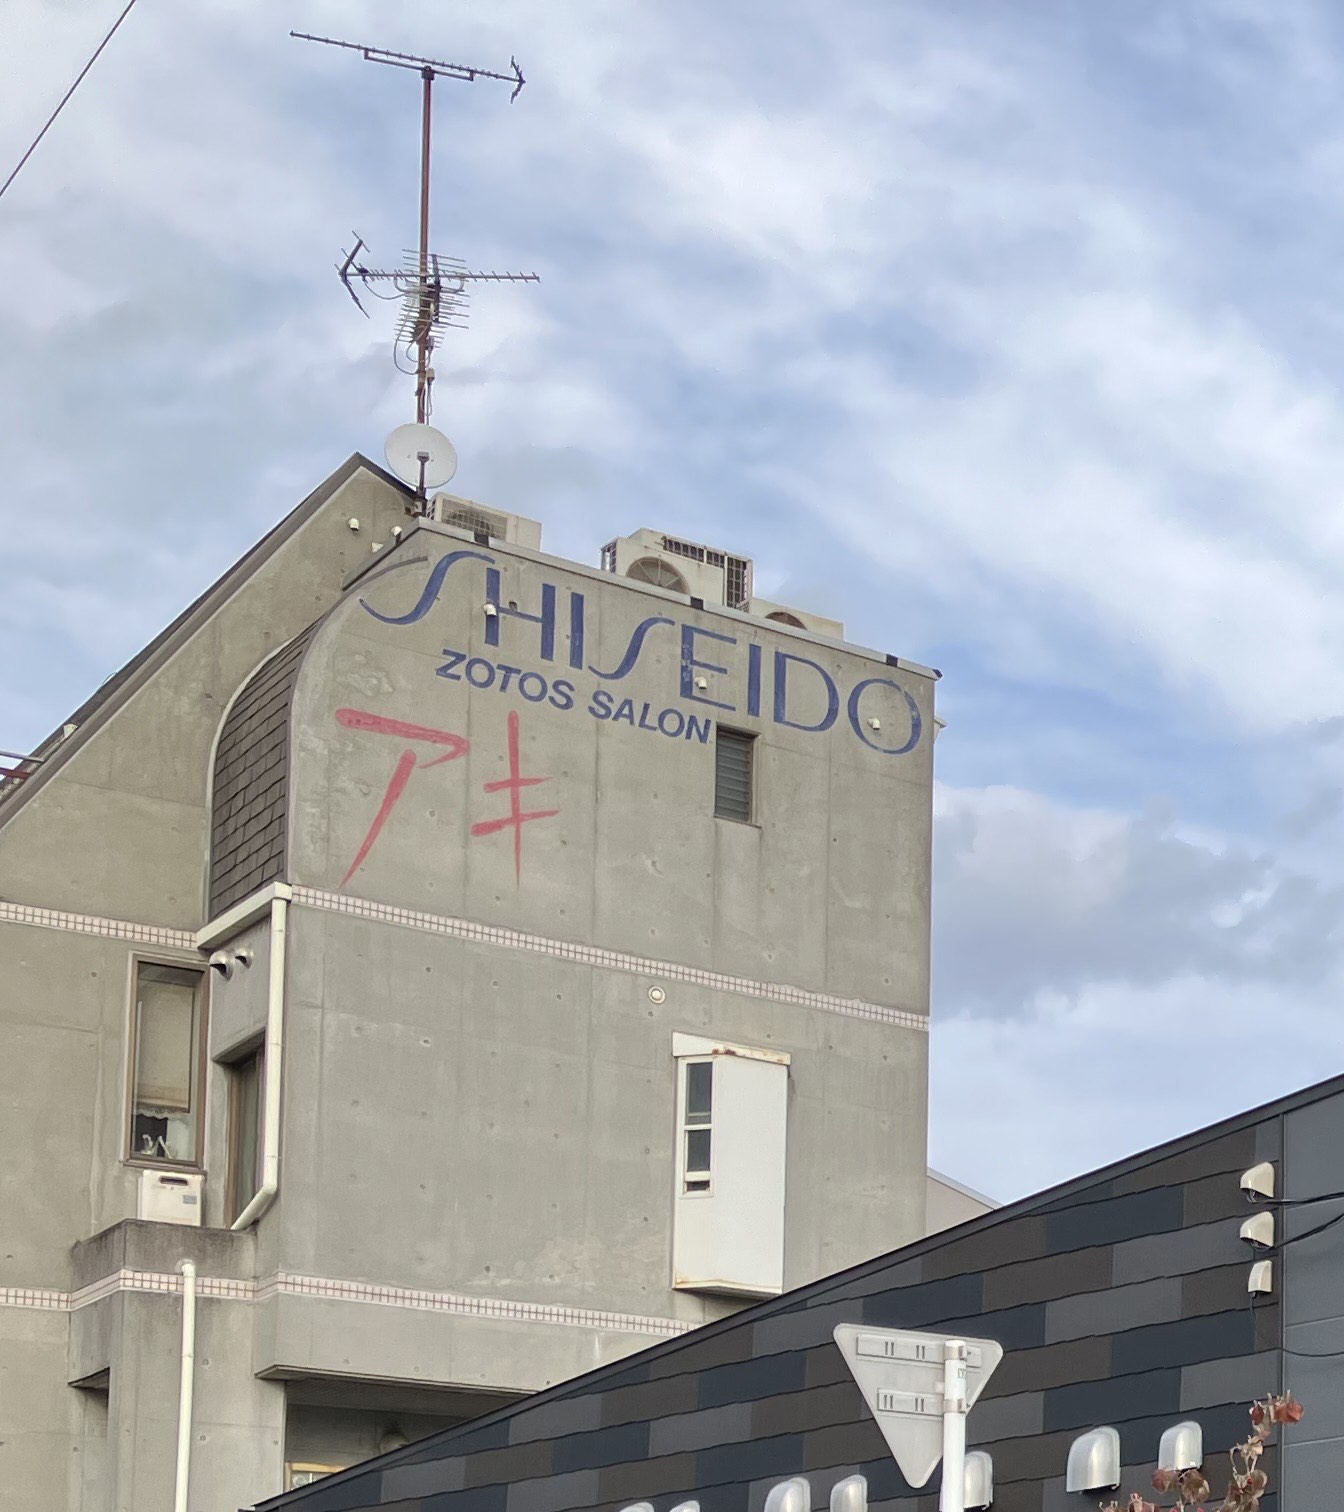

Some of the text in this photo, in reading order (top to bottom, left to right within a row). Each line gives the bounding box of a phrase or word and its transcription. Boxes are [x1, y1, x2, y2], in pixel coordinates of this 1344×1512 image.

[361, 550, 922, 755] SHISEIDO
[436, 649, 717, 744] ZOTOS SALON
[335, 707, 560, 889] アキ
